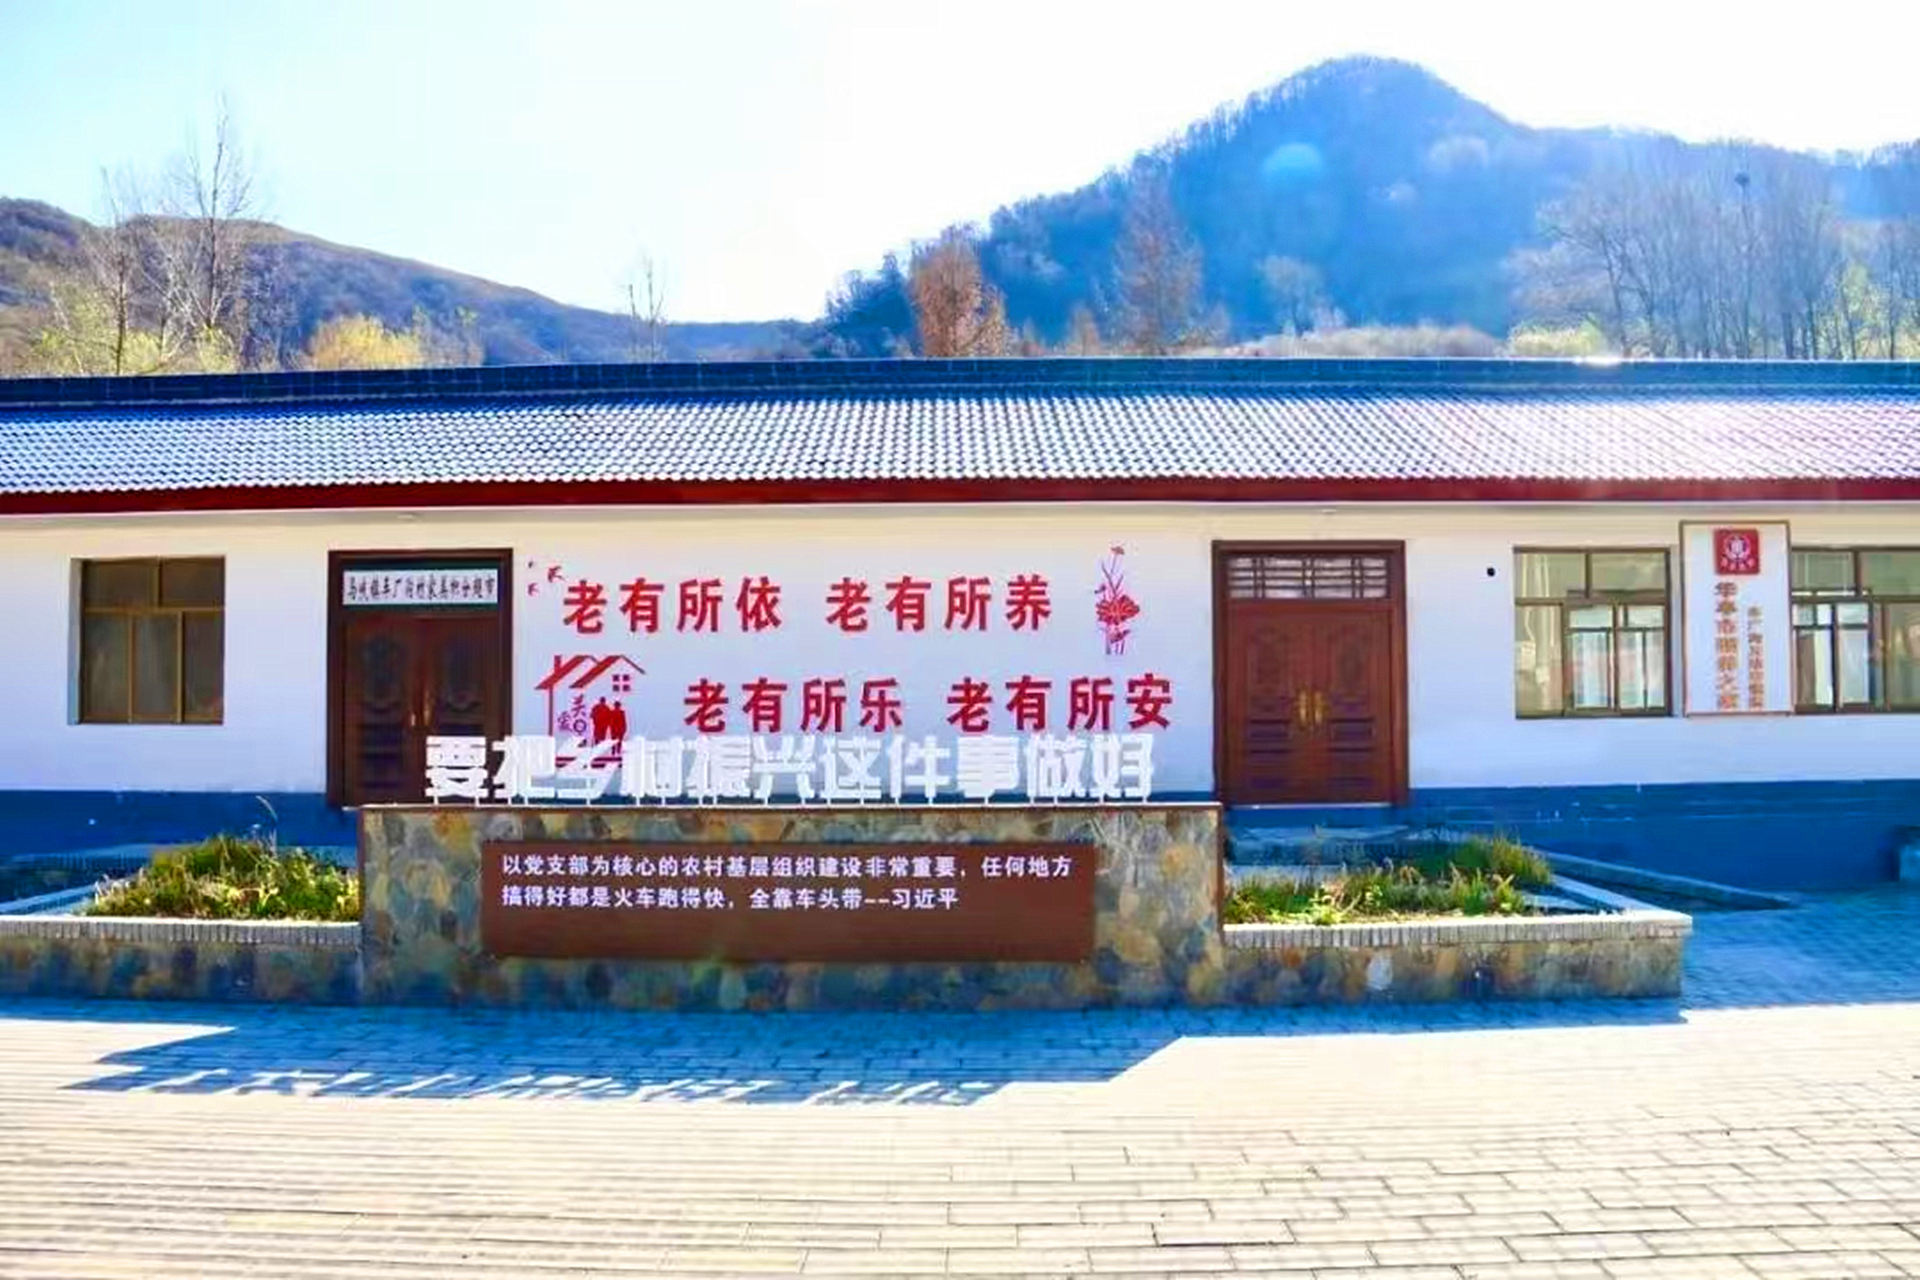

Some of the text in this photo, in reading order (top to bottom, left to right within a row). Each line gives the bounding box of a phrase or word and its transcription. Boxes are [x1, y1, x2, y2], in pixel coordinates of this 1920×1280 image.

[562, 575, 1052, 634] 老有所依 老有所养
[684, 672, 1174, 733] 老有所乐 老有所安
[425, 733, 1154, 803] 要把乡村振兴这件事做好
